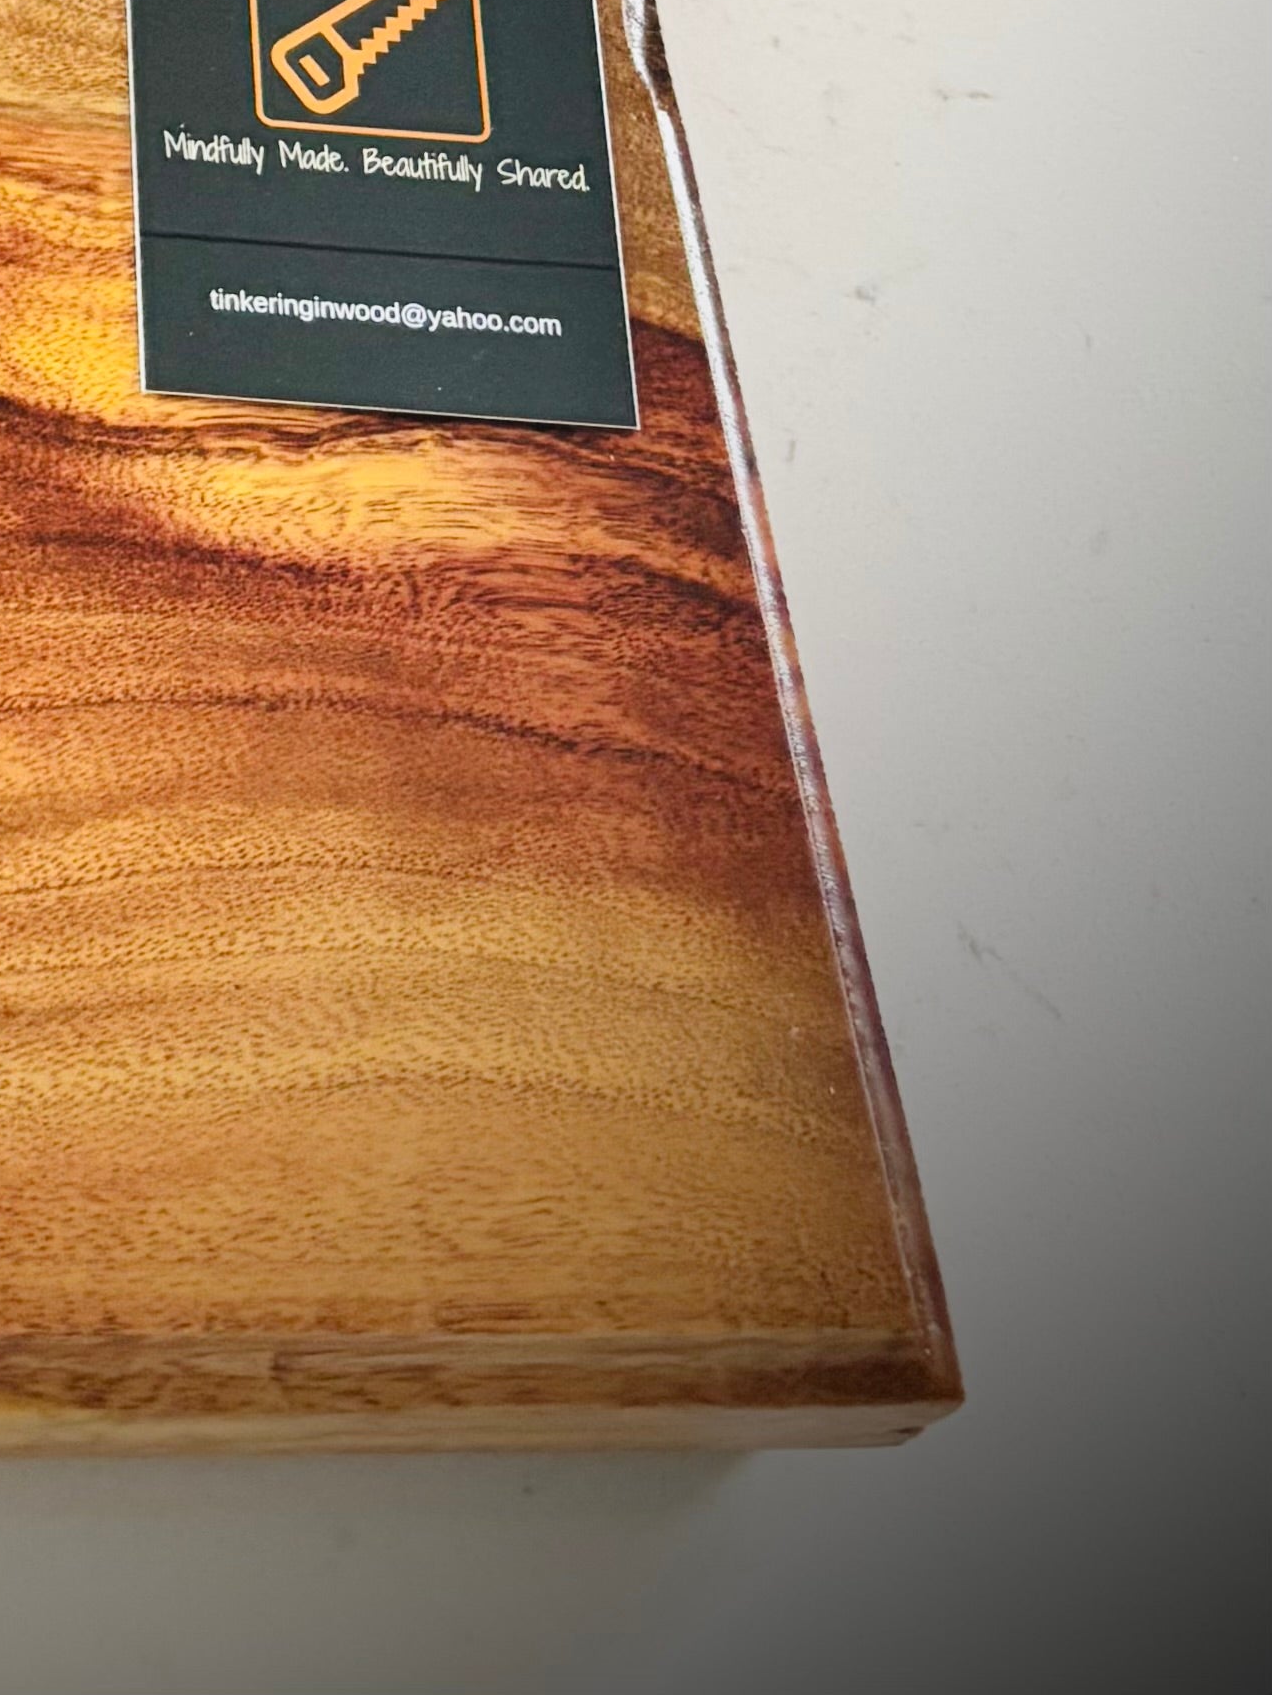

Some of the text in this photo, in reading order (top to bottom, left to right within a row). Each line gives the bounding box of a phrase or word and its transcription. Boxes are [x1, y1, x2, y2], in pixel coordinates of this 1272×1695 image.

[163, 123, 591, 193] Mindfully Made. Beautifully Shared.
[209, 287, 563, 338] tinkeringinwood@yahoo.com
